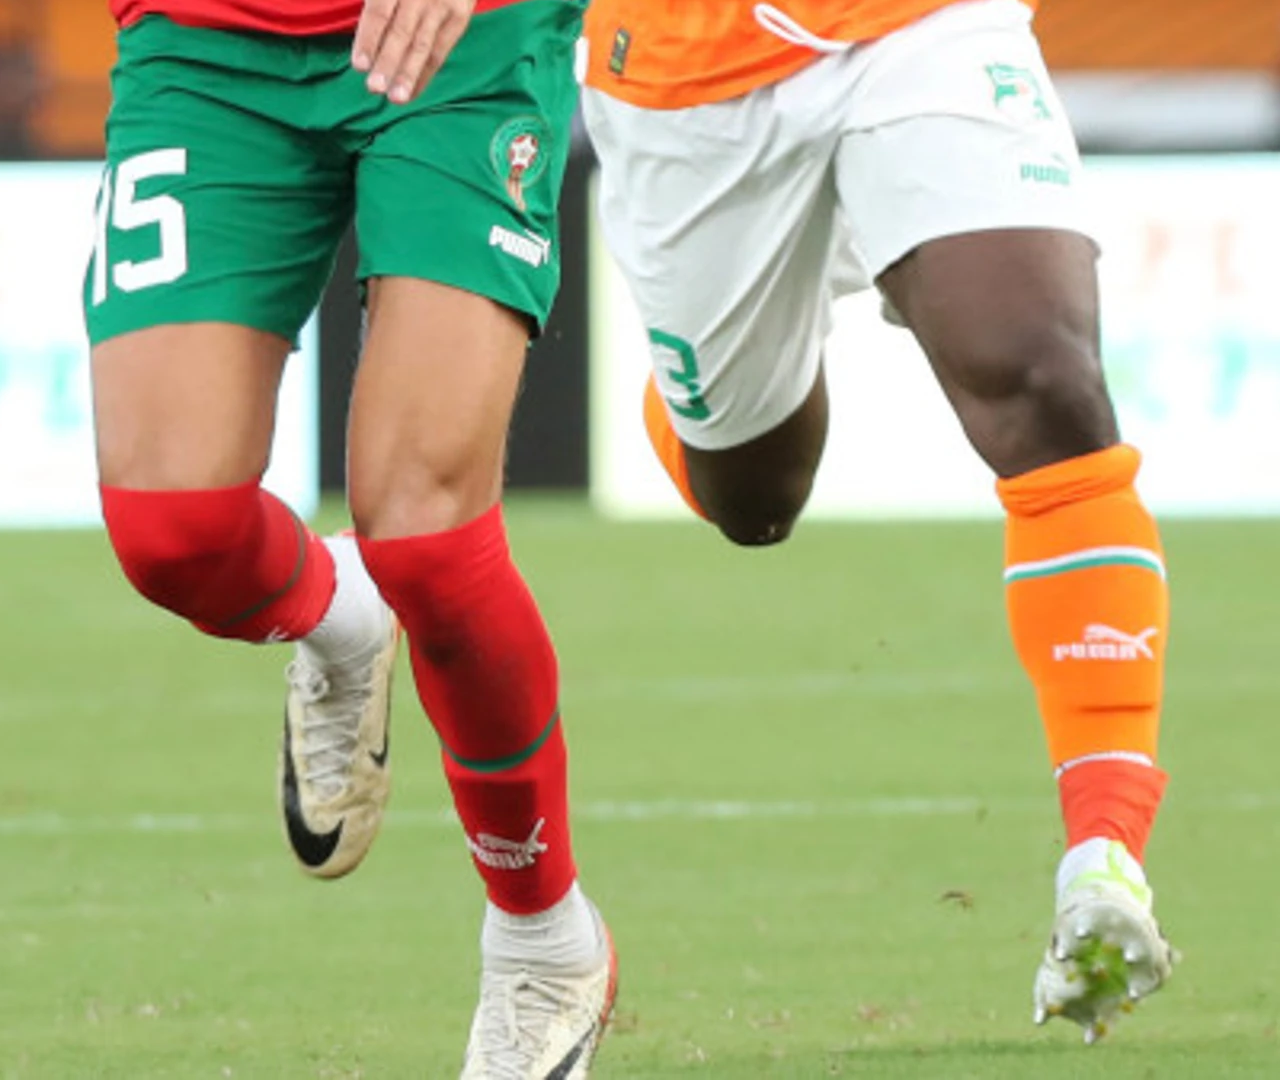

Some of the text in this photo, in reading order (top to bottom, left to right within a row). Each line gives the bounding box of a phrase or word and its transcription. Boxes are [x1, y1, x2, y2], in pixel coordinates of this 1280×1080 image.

[91, 147, 188, 307] 15
[646, 326, 712, 421] 3
[1053, 643, 1138, 661] PUMA
